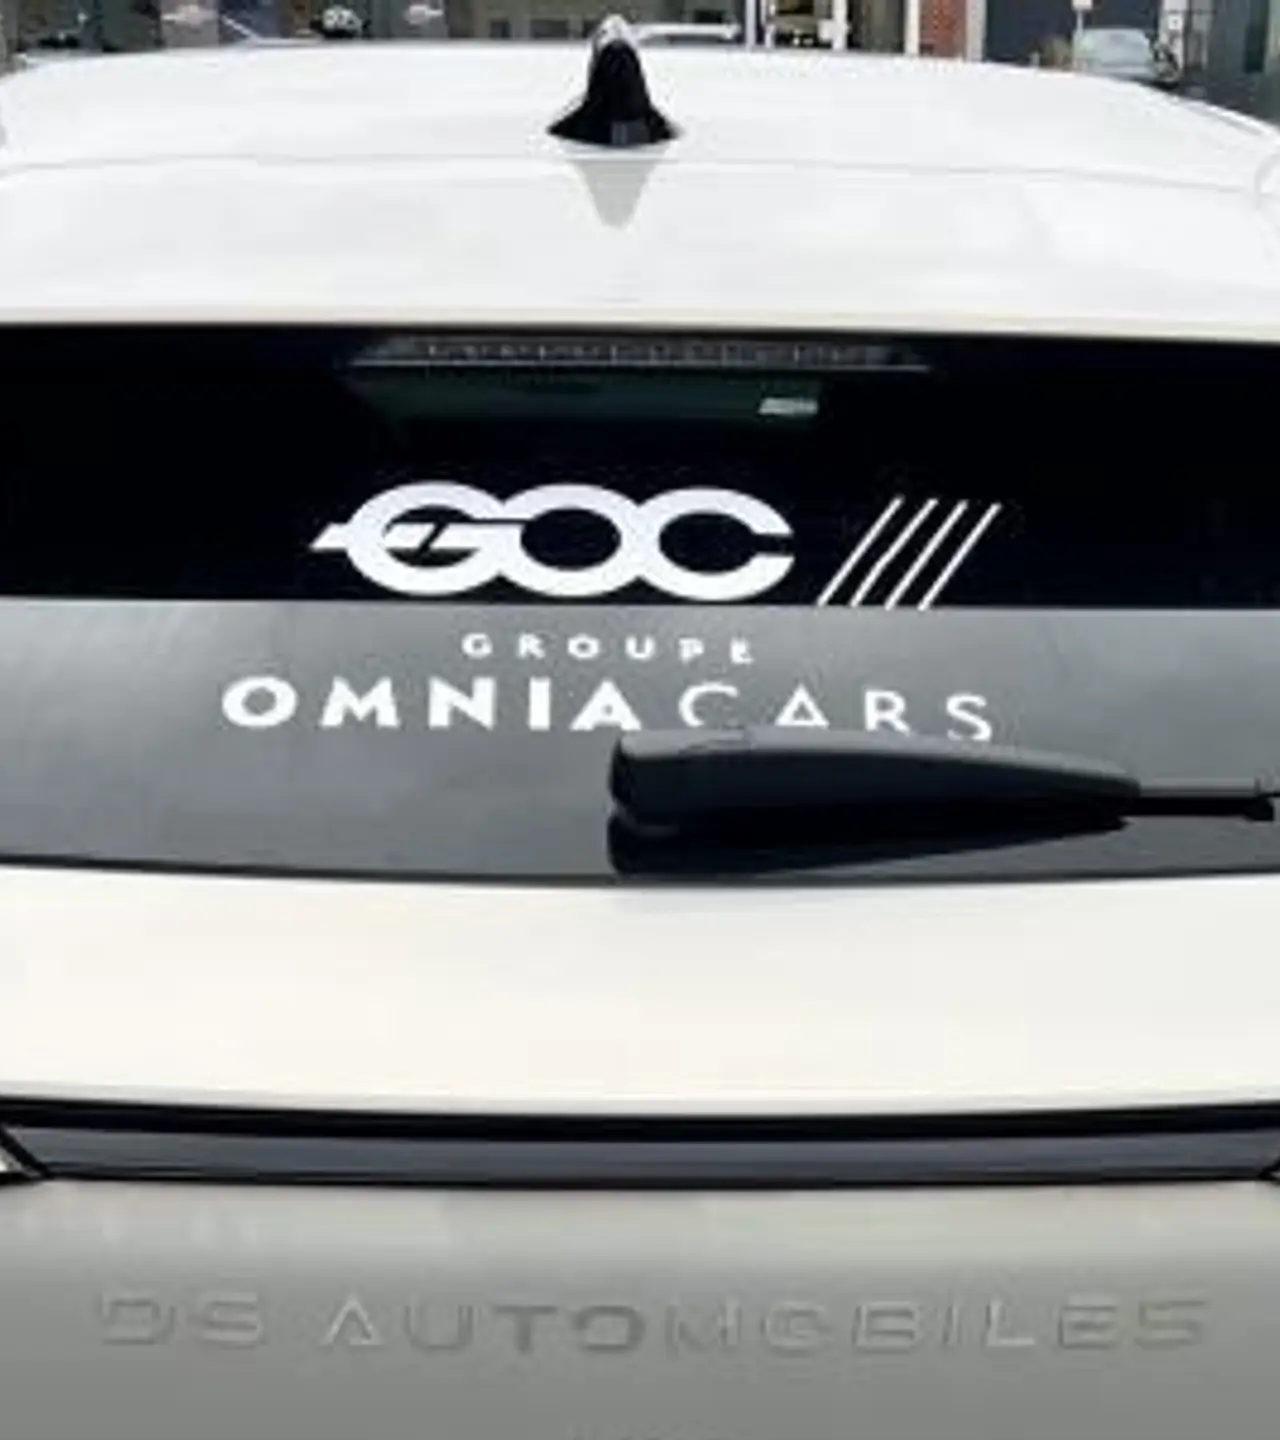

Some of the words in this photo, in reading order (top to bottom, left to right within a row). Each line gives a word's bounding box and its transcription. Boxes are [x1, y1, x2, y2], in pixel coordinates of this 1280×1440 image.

[310, 481, 795, 601] GOC
[461, 631, 755, 666] GROUPE
[102, 1296, 268, 1350] DS
[320, 1295, 1208, 1356] AUTOMOBILES
